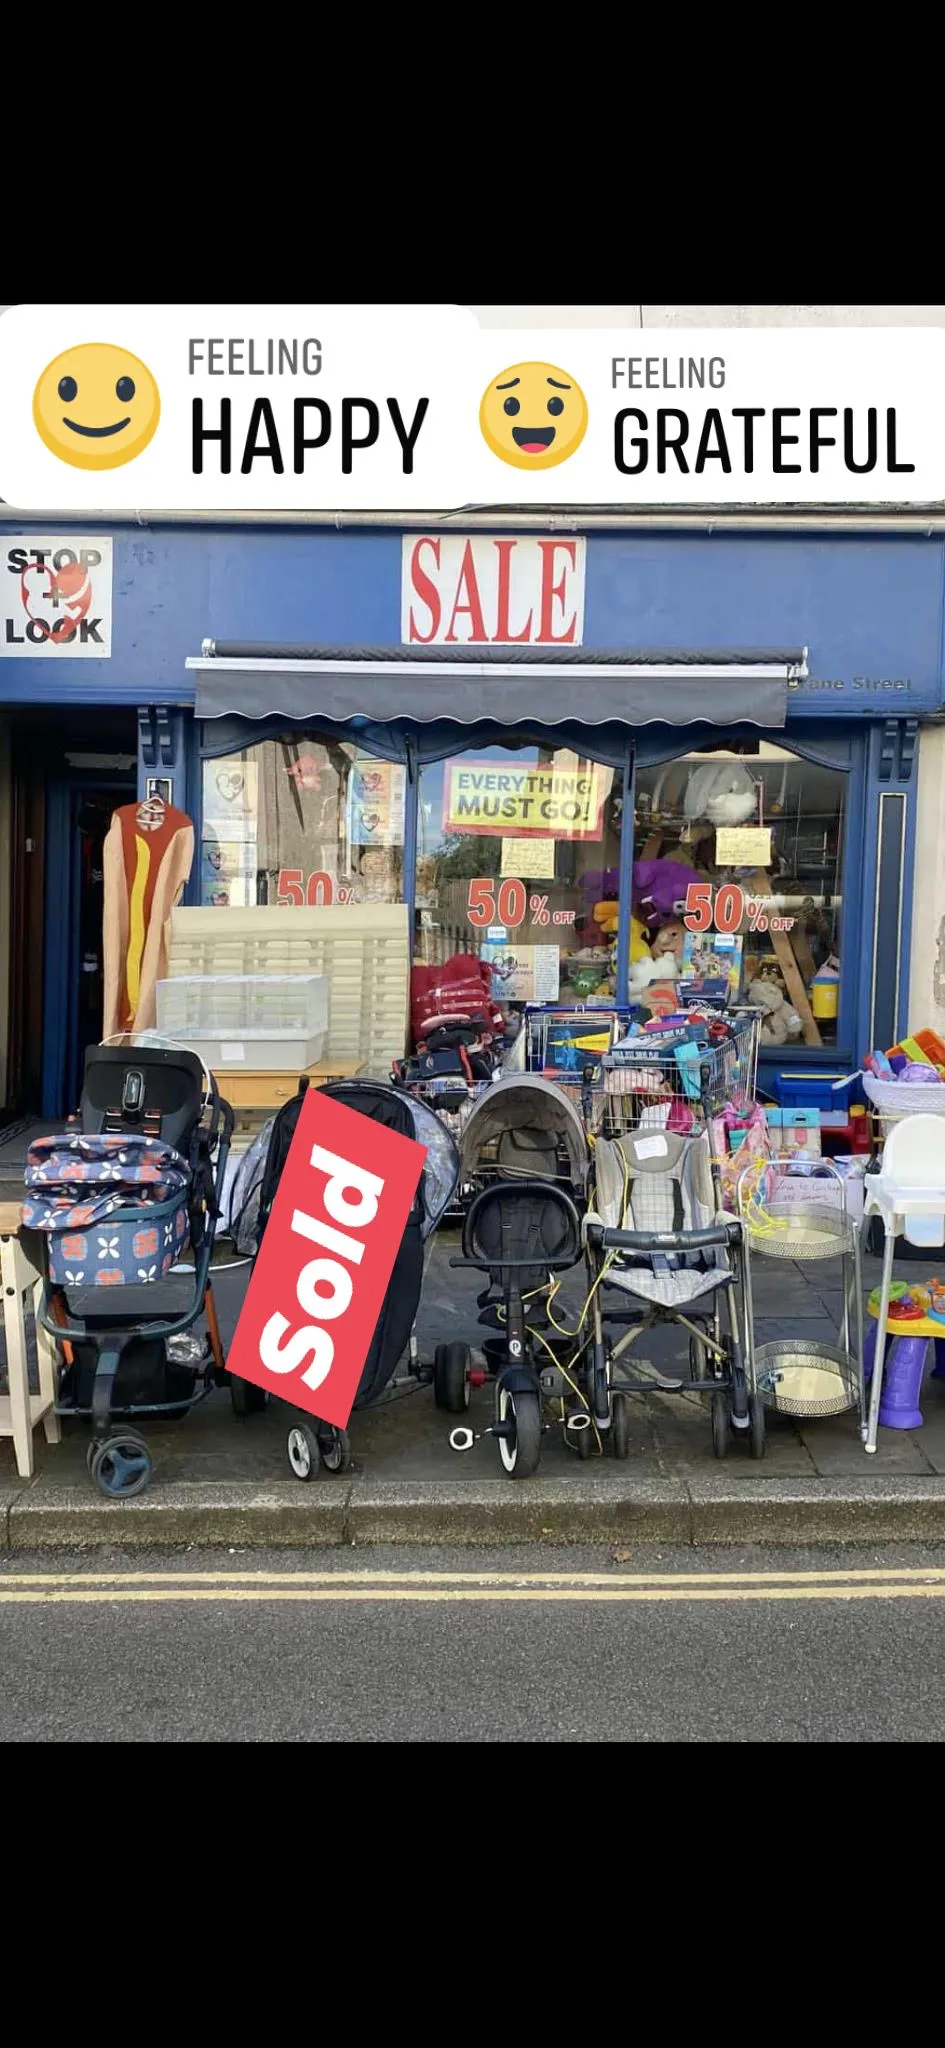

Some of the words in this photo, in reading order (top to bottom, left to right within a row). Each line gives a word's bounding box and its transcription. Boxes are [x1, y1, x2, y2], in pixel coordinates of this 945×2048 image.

[7, 548, 102, 574] STOP
[409, 537, 576, 643] SALE
[5, 618, 104, 643] LOOK
[852, 676, 911, 691] Street
[458, 773, 592, 796] EVERYTHING
[457, 795, 534, 818] MUST
[540, 799, 590, 822] GO!
[553, 910, 575, 926] OFF
[770, 917, 795, 931] OFF
